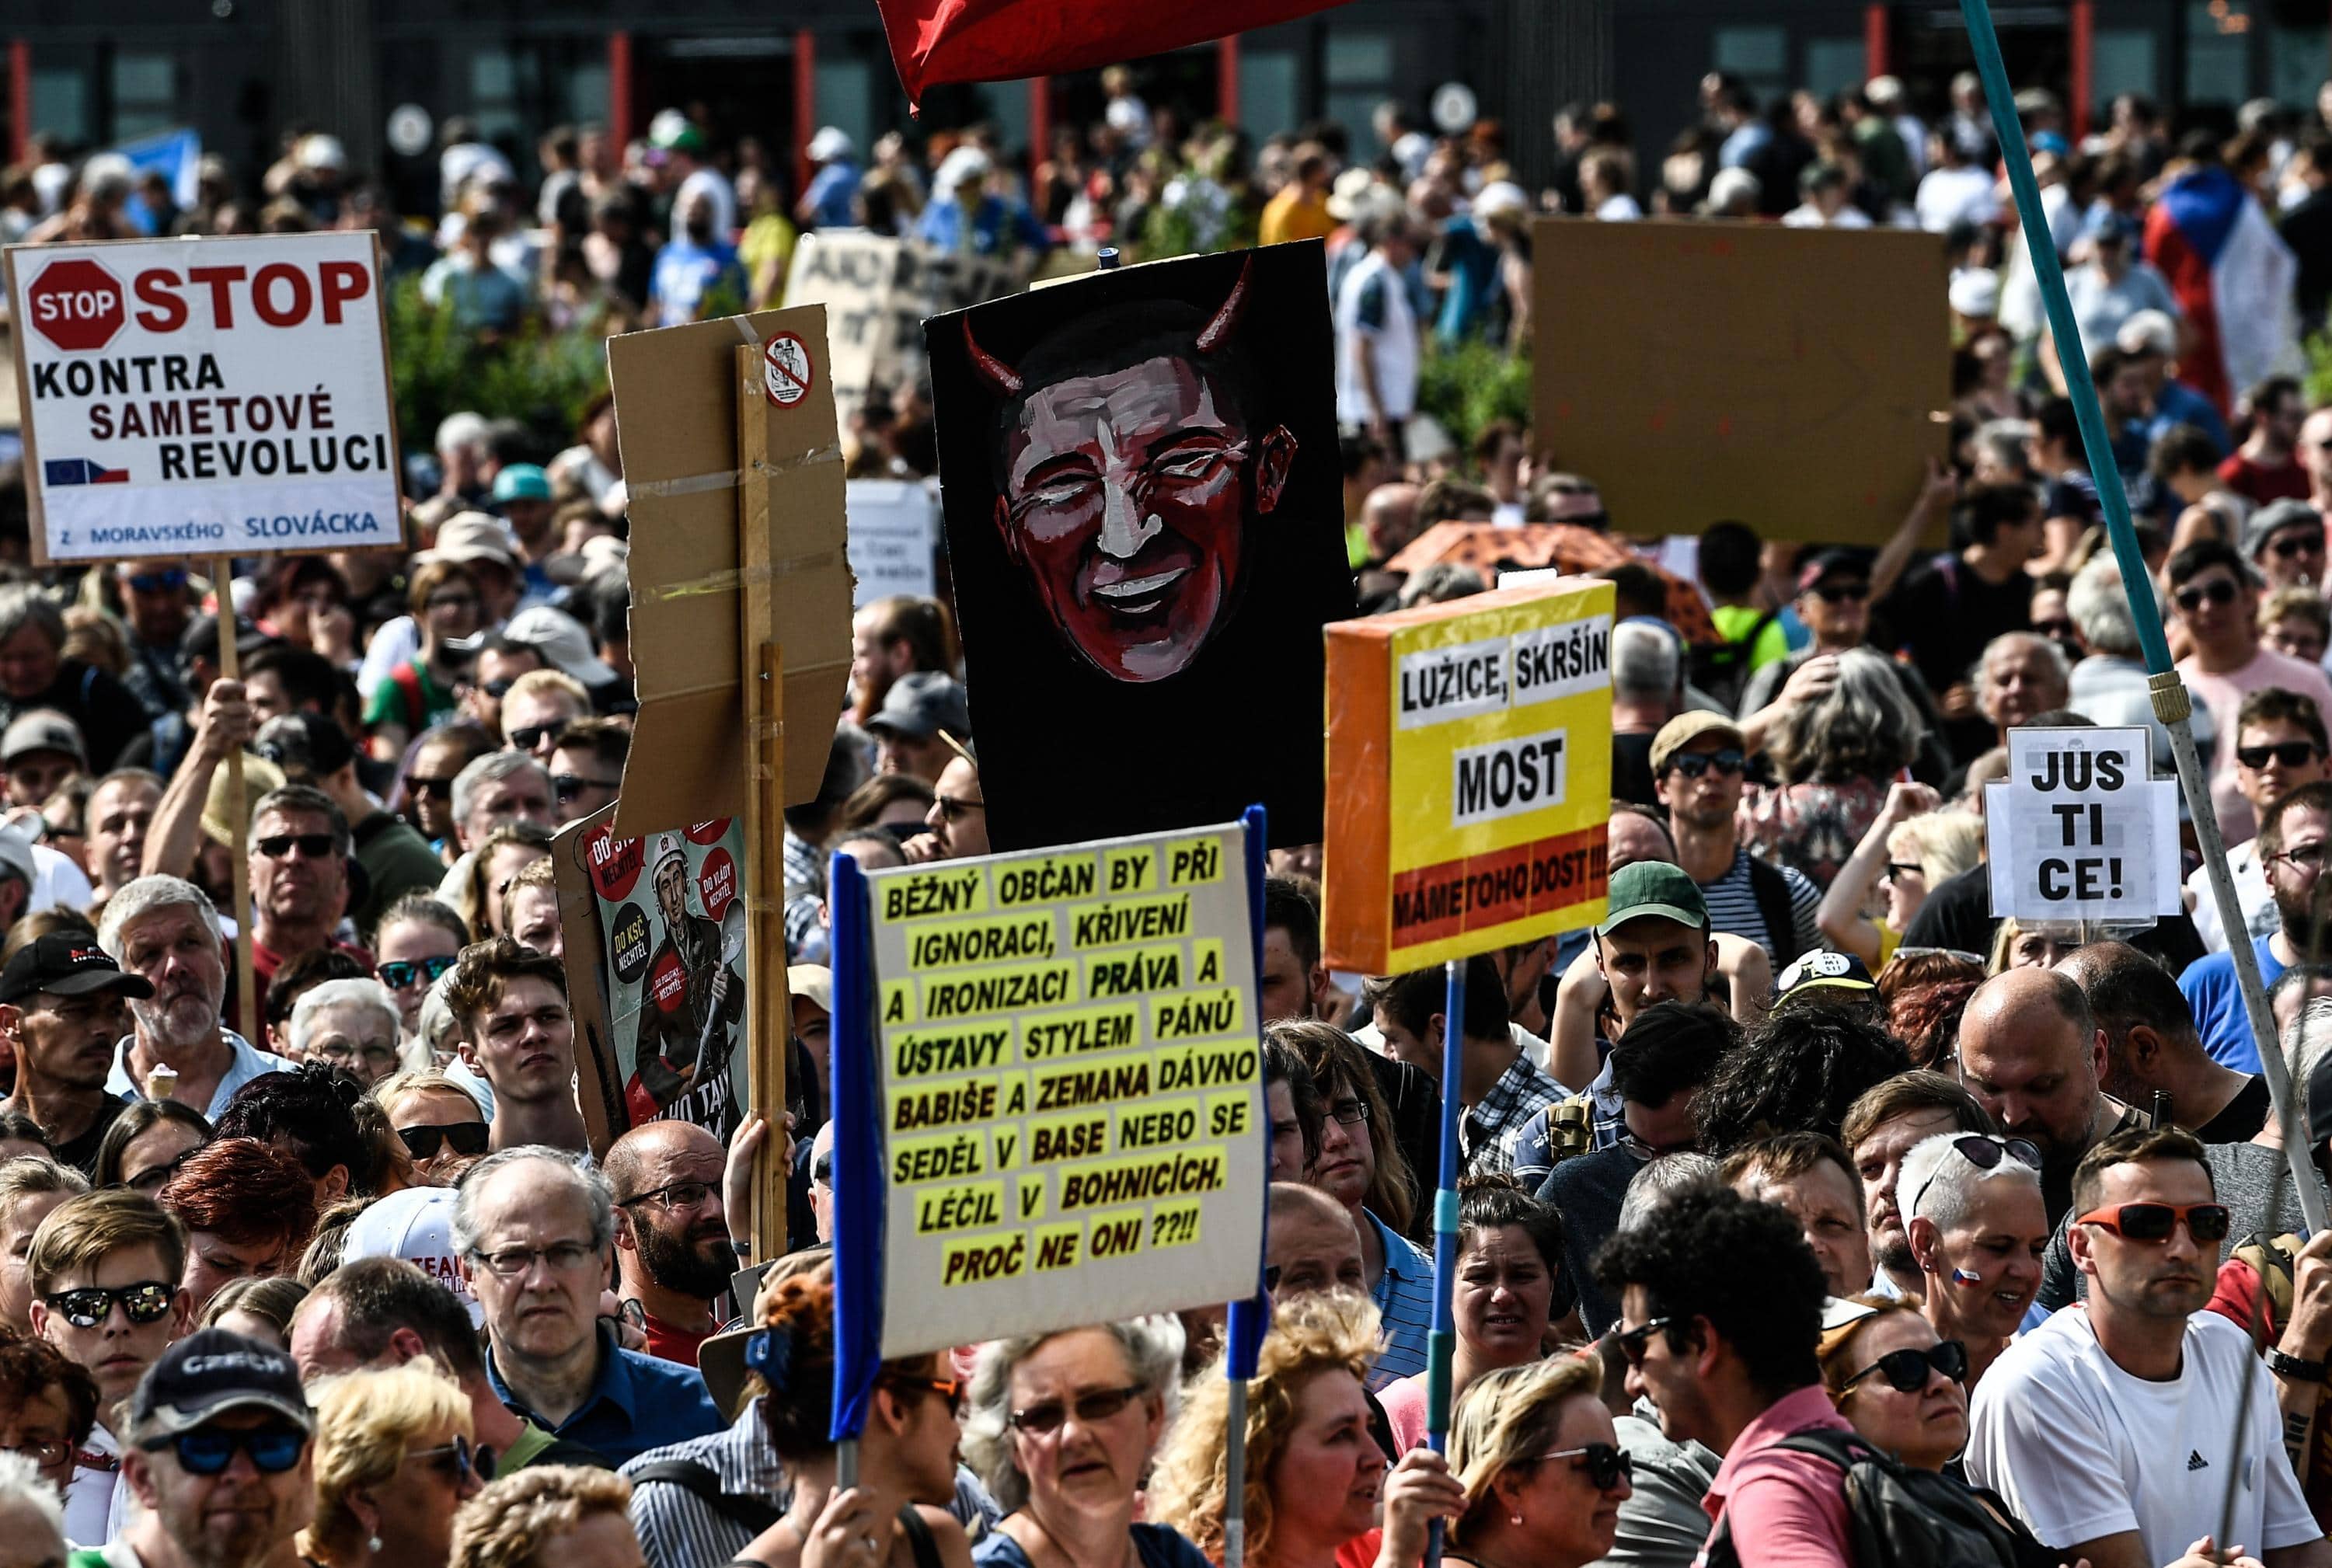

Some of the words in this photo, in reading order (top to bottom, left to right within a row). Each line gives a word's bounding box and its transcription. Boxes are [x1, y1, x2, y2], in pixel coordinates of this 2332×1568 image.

[37, 291, 115, 320] STOP
[134, 261, 371, 333] STOP
[33, 353, 225, 399] KONTRA
[89, 384, 334, 441] SAMETOVÉ
[160, 434, 388, 480] REVOLUCI
[91, 522, 225, 544] MORAVSKÉHO
[246, 510, 379, 538] SLOVÁCKA
[1402, 653, 1508, 713] LUŽICE,
[1515, 625, 1609, 690] SKRŠÍN
[1458, 737, 1563, 816] MOST
[2031, 750, 2125, 792] JUS
[2052, 803, 2104, 846] TI
[592, 835, 610, 866] DO
[703, 877, 713, 894] DO
[886, 871, 979, 921] BĚŽNÝ
[1000, 861, 1095, 904] OBČAN
[1110, 855, 1149, 890] BY
[1171, 843, 1218, 884] PŘI
[2038, 857, 2123, 901] CE!
[614, 931, 626, 955] DO
[627, 914, 645, 945] KSČ
[913, 920, 1056, 967] IGNORACI,
[1075, 894, 1190, 947] KŘIVENÍ
[618, 941, 647, 972] NECHTĚL
[886, 990, 905, 1023] A
[926, 970, 1069, 1018] IRONIZACI
[1090, 950, 1180, 998] PRÁVA
[1198, 950, 1218, 982] A
[896, 1031, 1008, 1078] ÚSTAVY
[1025, 1013, 1134, 1059] STYLEM
[1156, 991, 1234, 1040] PÁNŮ
[894, 1080, 997, 1131] BABIŠE
[1007, 1082, 1026, 1114] A
[1036, 1064, 1150, 1112] ZEMANA
[1159, 1051, 1256, 1091] DÁVNO
[894, 1135, 981, 1183] SEDĚL
[997, 1138, 1016, 1169] V
[1032, 1120, 1105, 1163] BASE
[1120, 1109, 1195, 1149] NEBO
[1211, 1102, 1247, 1137] SE
[918, 1186, 1000, 1232] LÉČIL
[1021, 1186, 1040, 1218] V
[1061, 1154, 1223, 1211] BOHNICÍCH.
[411, 1256, 462, 1277] TEA
[943, 1239, 1026, 1285] PROČ
[1036, 1235, 1078, 1270] NE
[1090, 1218, 1143, 1258] ONI
[1152, 1211, 1198, 1245] ??!!
[182, 1351, 287, 1375] CZECH
